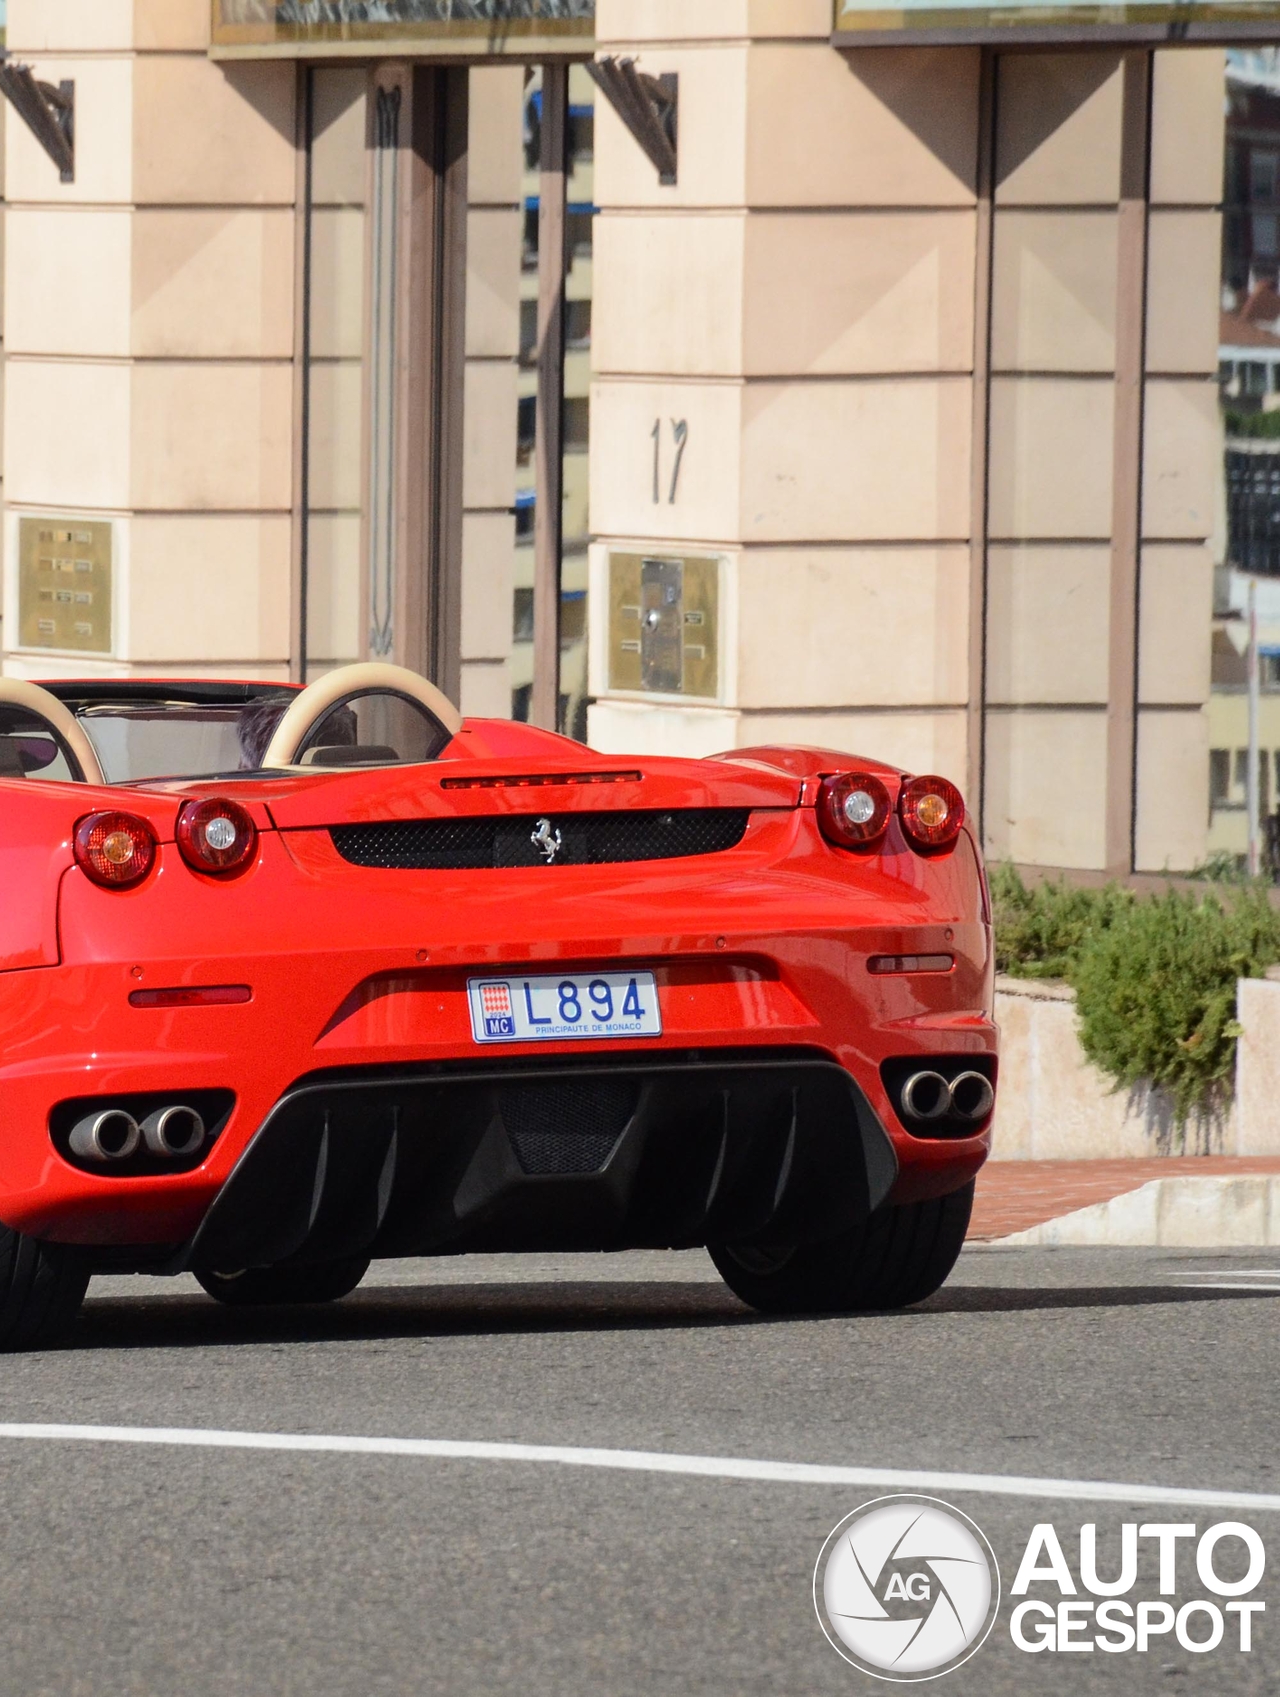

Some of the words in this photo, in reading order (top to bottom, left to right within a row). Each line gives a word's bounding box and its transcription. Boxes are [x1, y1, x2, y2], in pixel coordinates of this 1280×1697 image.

[651, 417, 688, 504] 17
[524, 978, 645, 1024] L894
[490, 1019, 509, 1033] MC
[535, 1025, 589, 1034] PRINCIPAUTE
[592, 1024, 603, 1032] DE
[606, 1022, 642, 1032] MONACO
